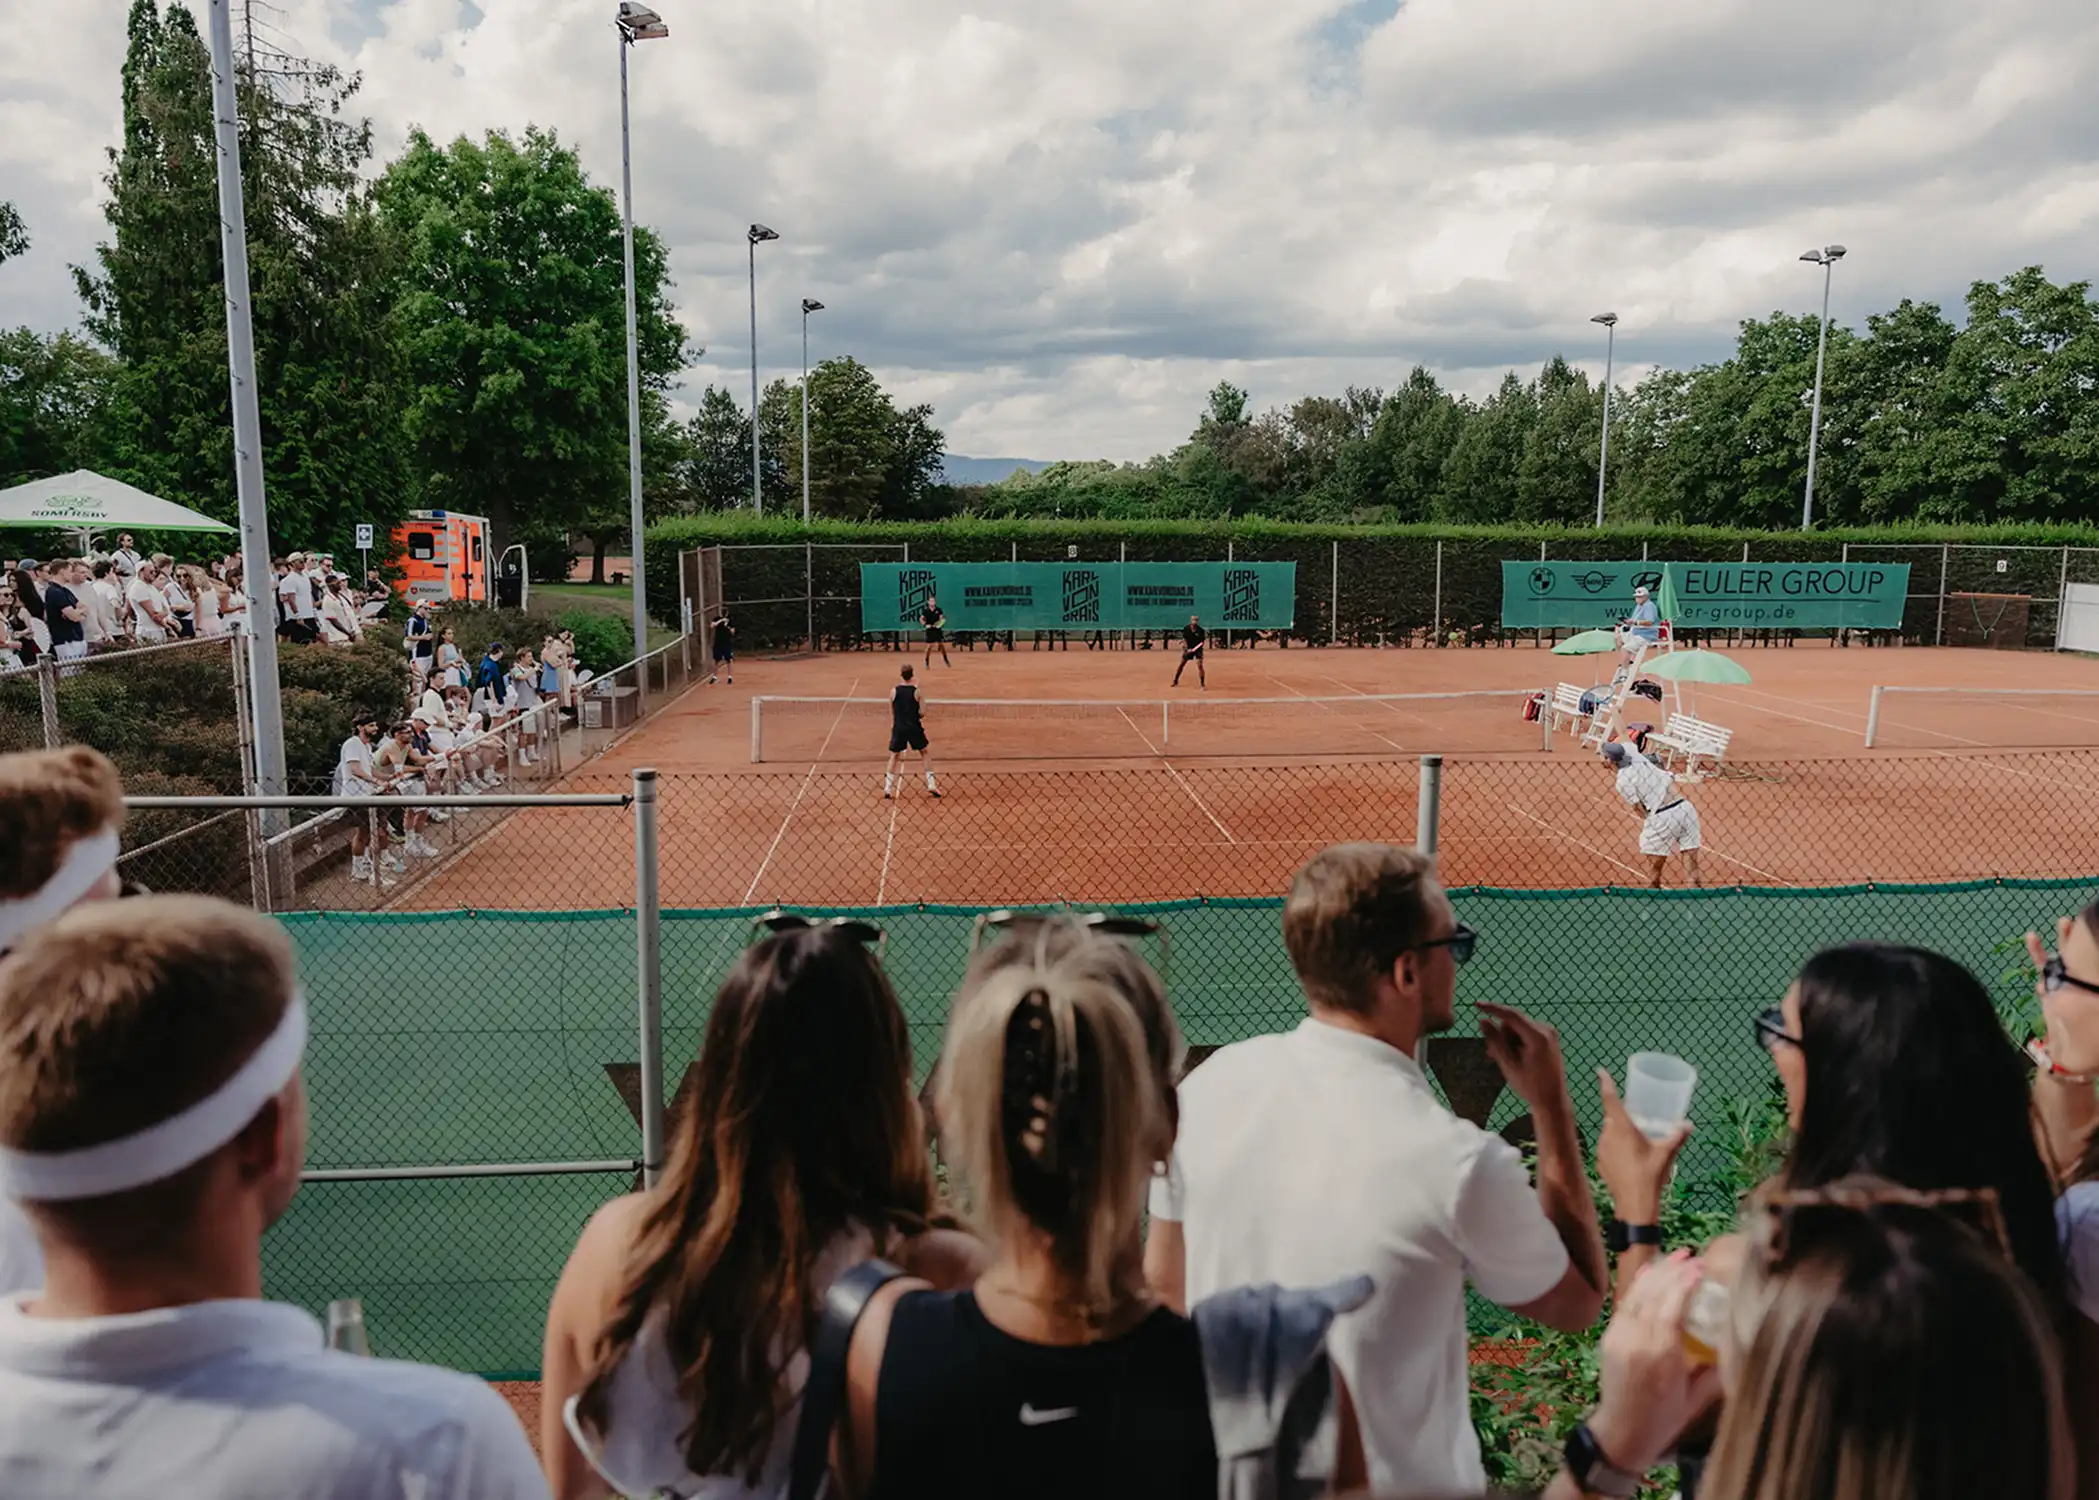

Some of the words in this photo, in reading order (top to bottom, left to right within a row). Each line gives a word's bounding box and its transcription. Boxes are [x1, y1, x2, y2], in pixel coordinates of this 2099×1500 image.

[899, 570, 936, 594] KARL
[1062, 570, 1099, 594] KARL
[1223, 570, 1259, 594] KARL
[1685, 570, 1773, 594] EULER
[1781, 569, 1884, 595] GROUP
[899, 581, 936, 612] VON
[1062, 581, 1099, 612] VON
[1223, 580, 1259, 611] VON
